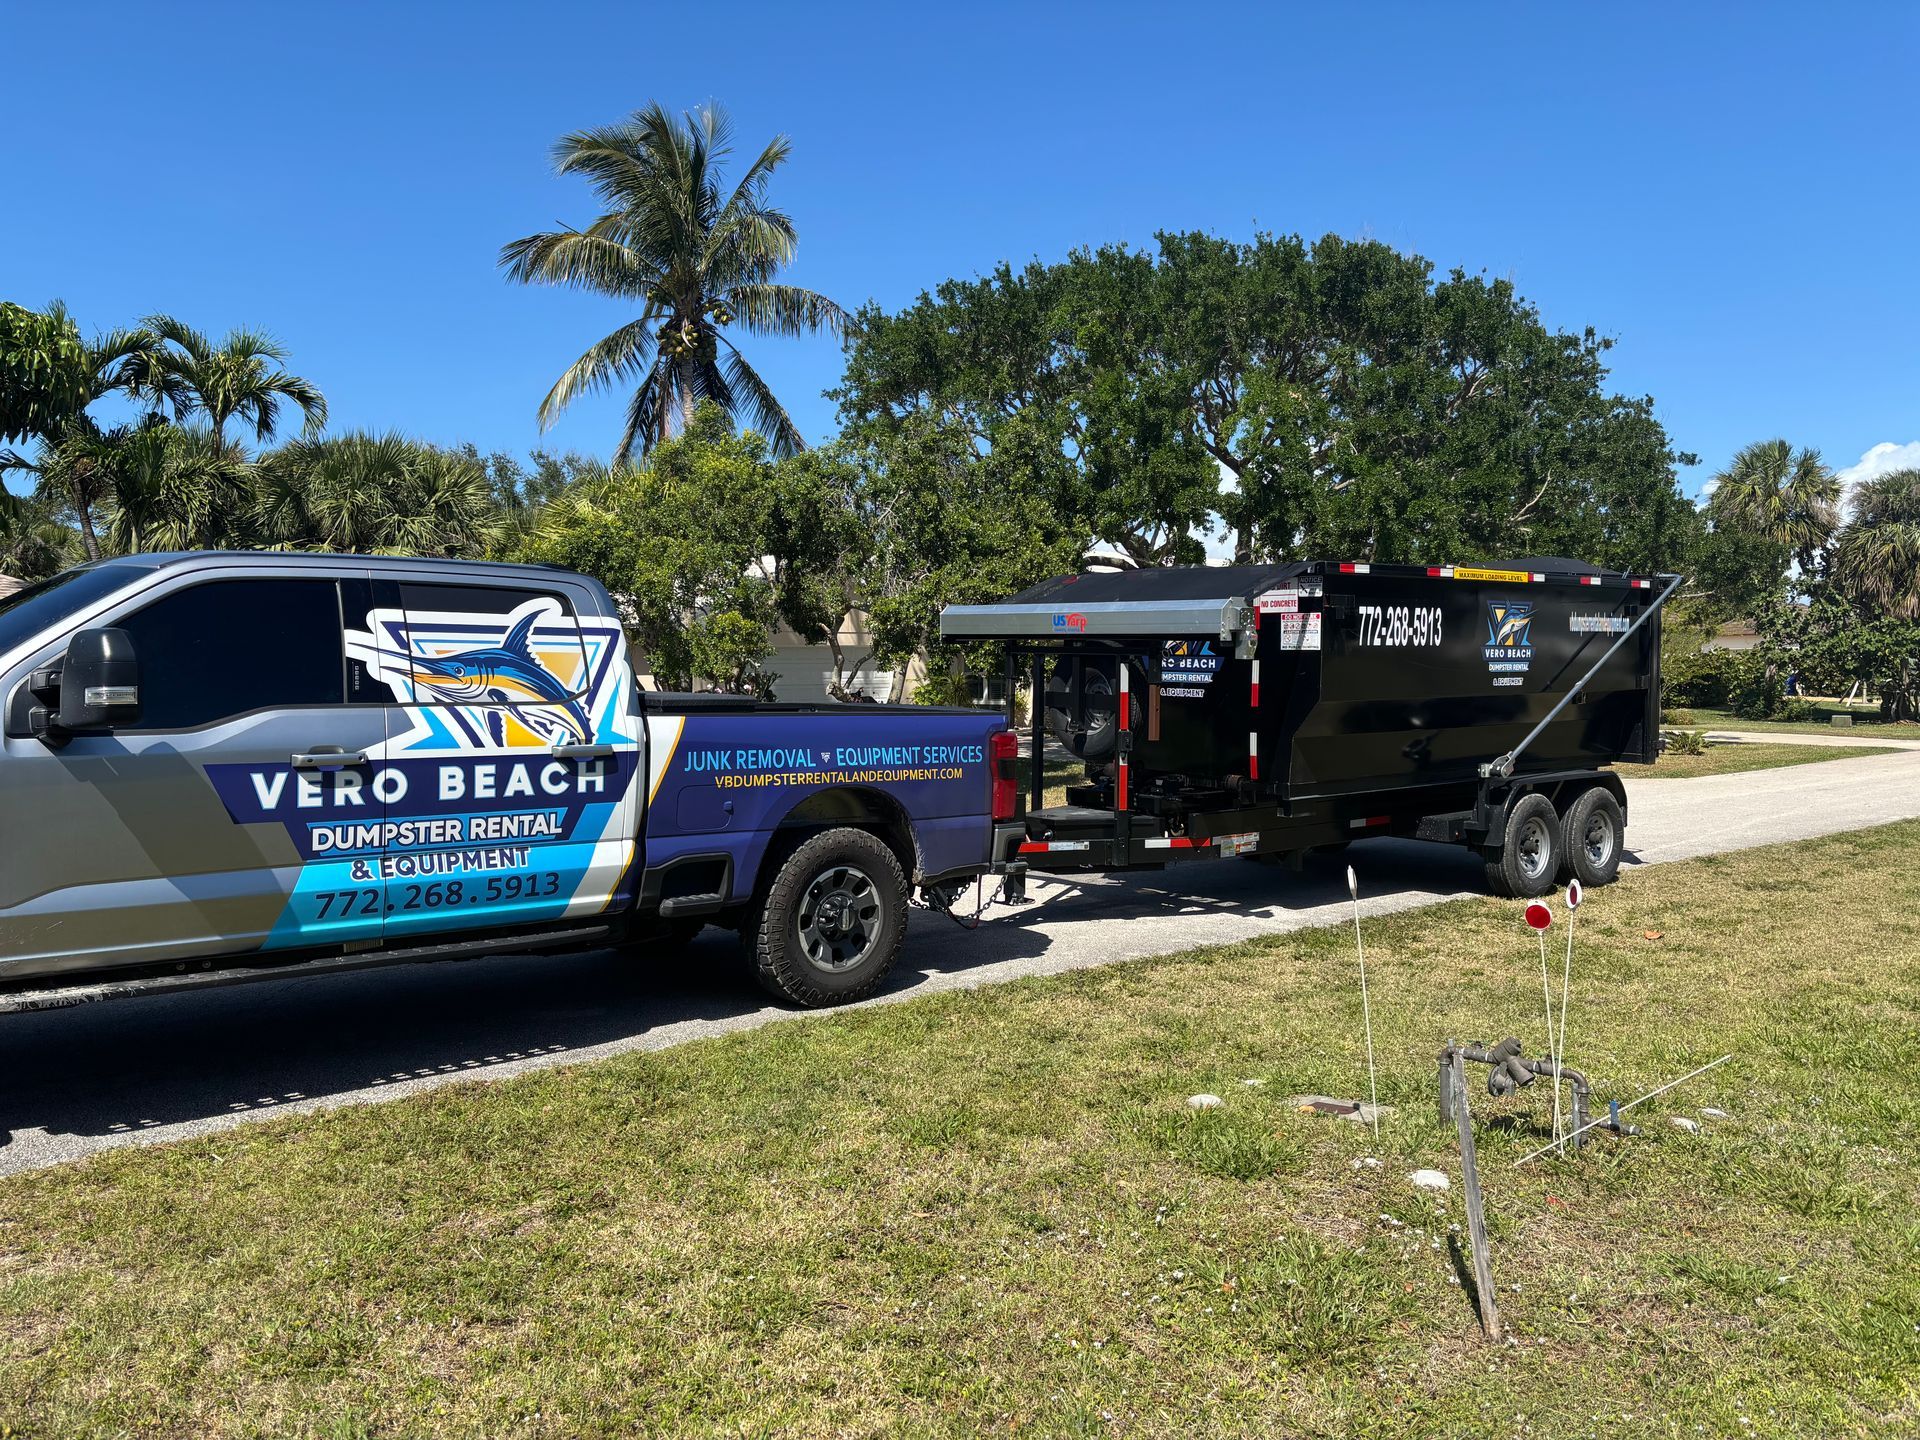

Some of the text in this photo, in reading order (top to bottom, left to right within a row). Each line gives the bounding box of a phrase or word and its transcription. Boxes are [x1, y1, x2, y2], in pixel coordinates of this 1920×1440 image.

[1261, 599, 1297, 608] NO CONCRETE
[1358, 605, 1442, 647] 772-268-5913
[1179, 658, 1216, 669] BEACH
[1485, 649, 1531, 658] VERO BEACH
[1162, 673, 1213, 682] MPSTER RENTAL
[1167, 688, 1205, 698] EQUIPMENT
[684, 745, 983, 772] JUNK REMOVAL EQUIPMENT SERVICES
[250, 760, 605, 811] VERO BEACH
[714, 767, 963, 789] VBDUMPSTERRENTALANDEQUIPMENT.COM
[311, 812, 563, 851] DUMPSTER RENTAL
[350, 846, 531, 882] & EQUIPMENT
[315, 872, 561, 920] 772.268.5913
